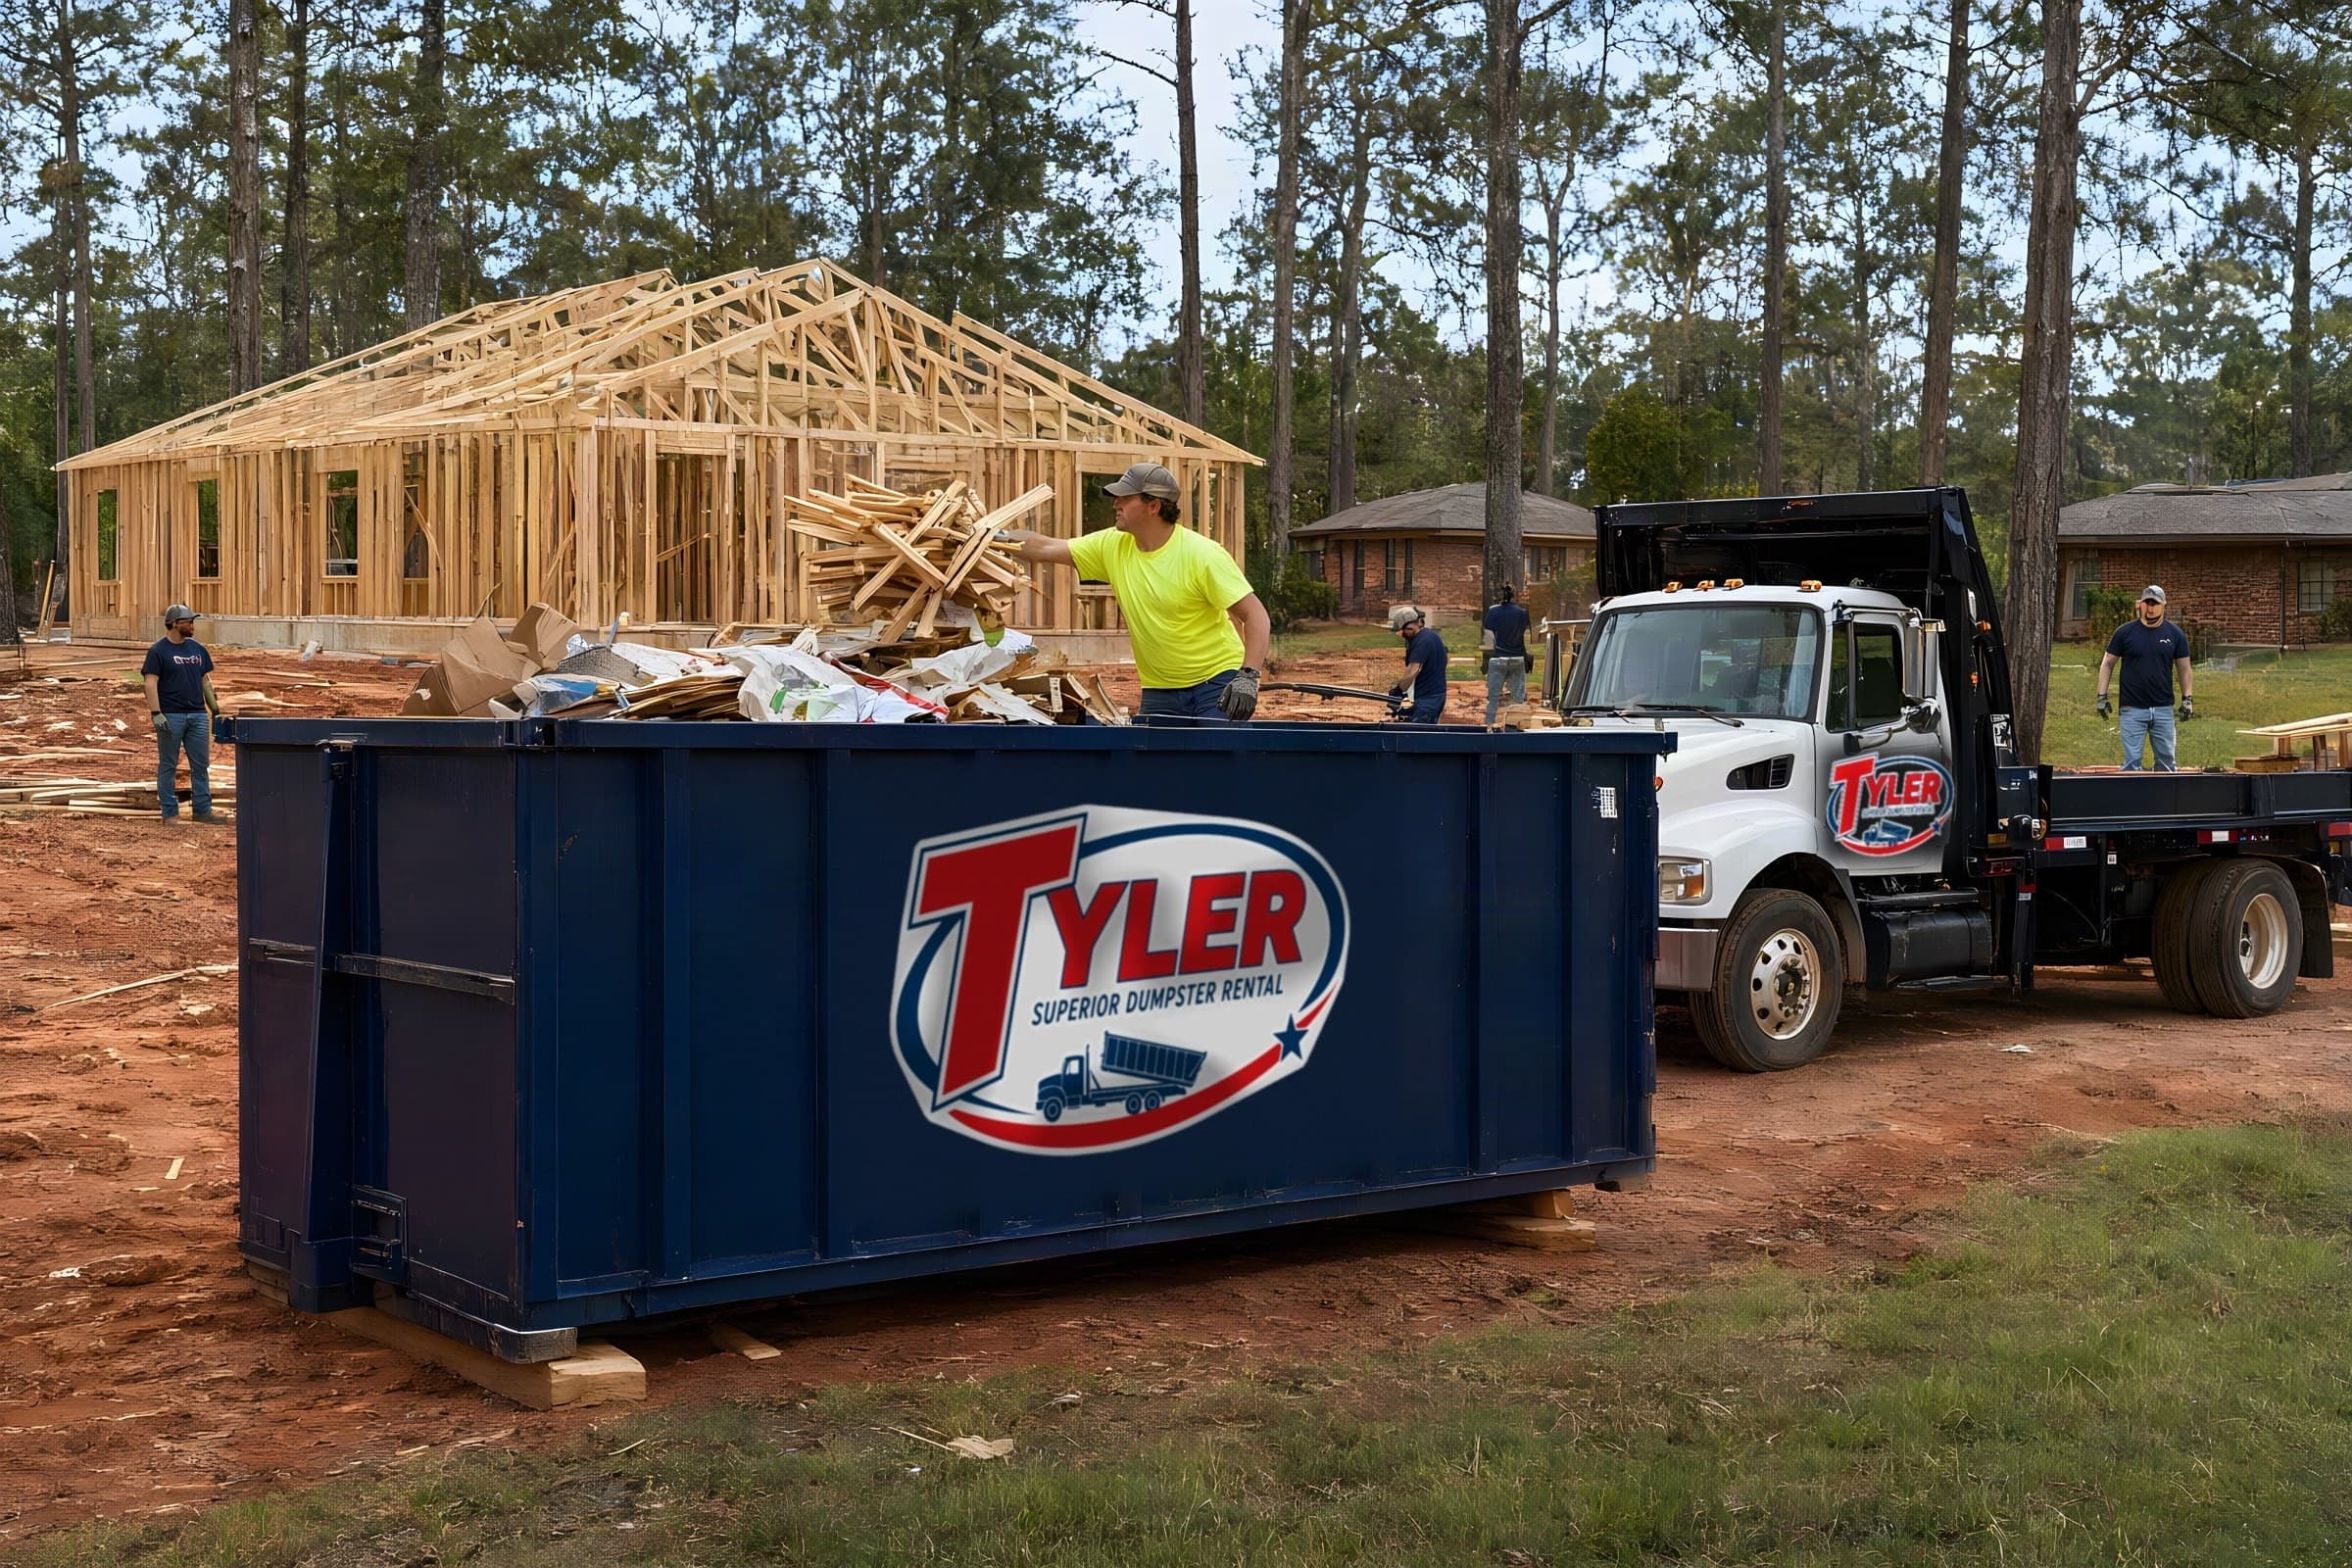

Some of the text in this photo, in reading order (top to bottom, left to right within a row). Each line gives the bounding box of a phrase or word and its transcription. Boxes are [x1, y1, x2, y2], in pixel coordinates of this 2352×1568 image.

[1833, 758, 1941, 836] TYLER
[918, 825, 1307, 1097] TYLER
[1032, 974, 1284, 1026] SUPERIOR DUMPSTER RENTAL
